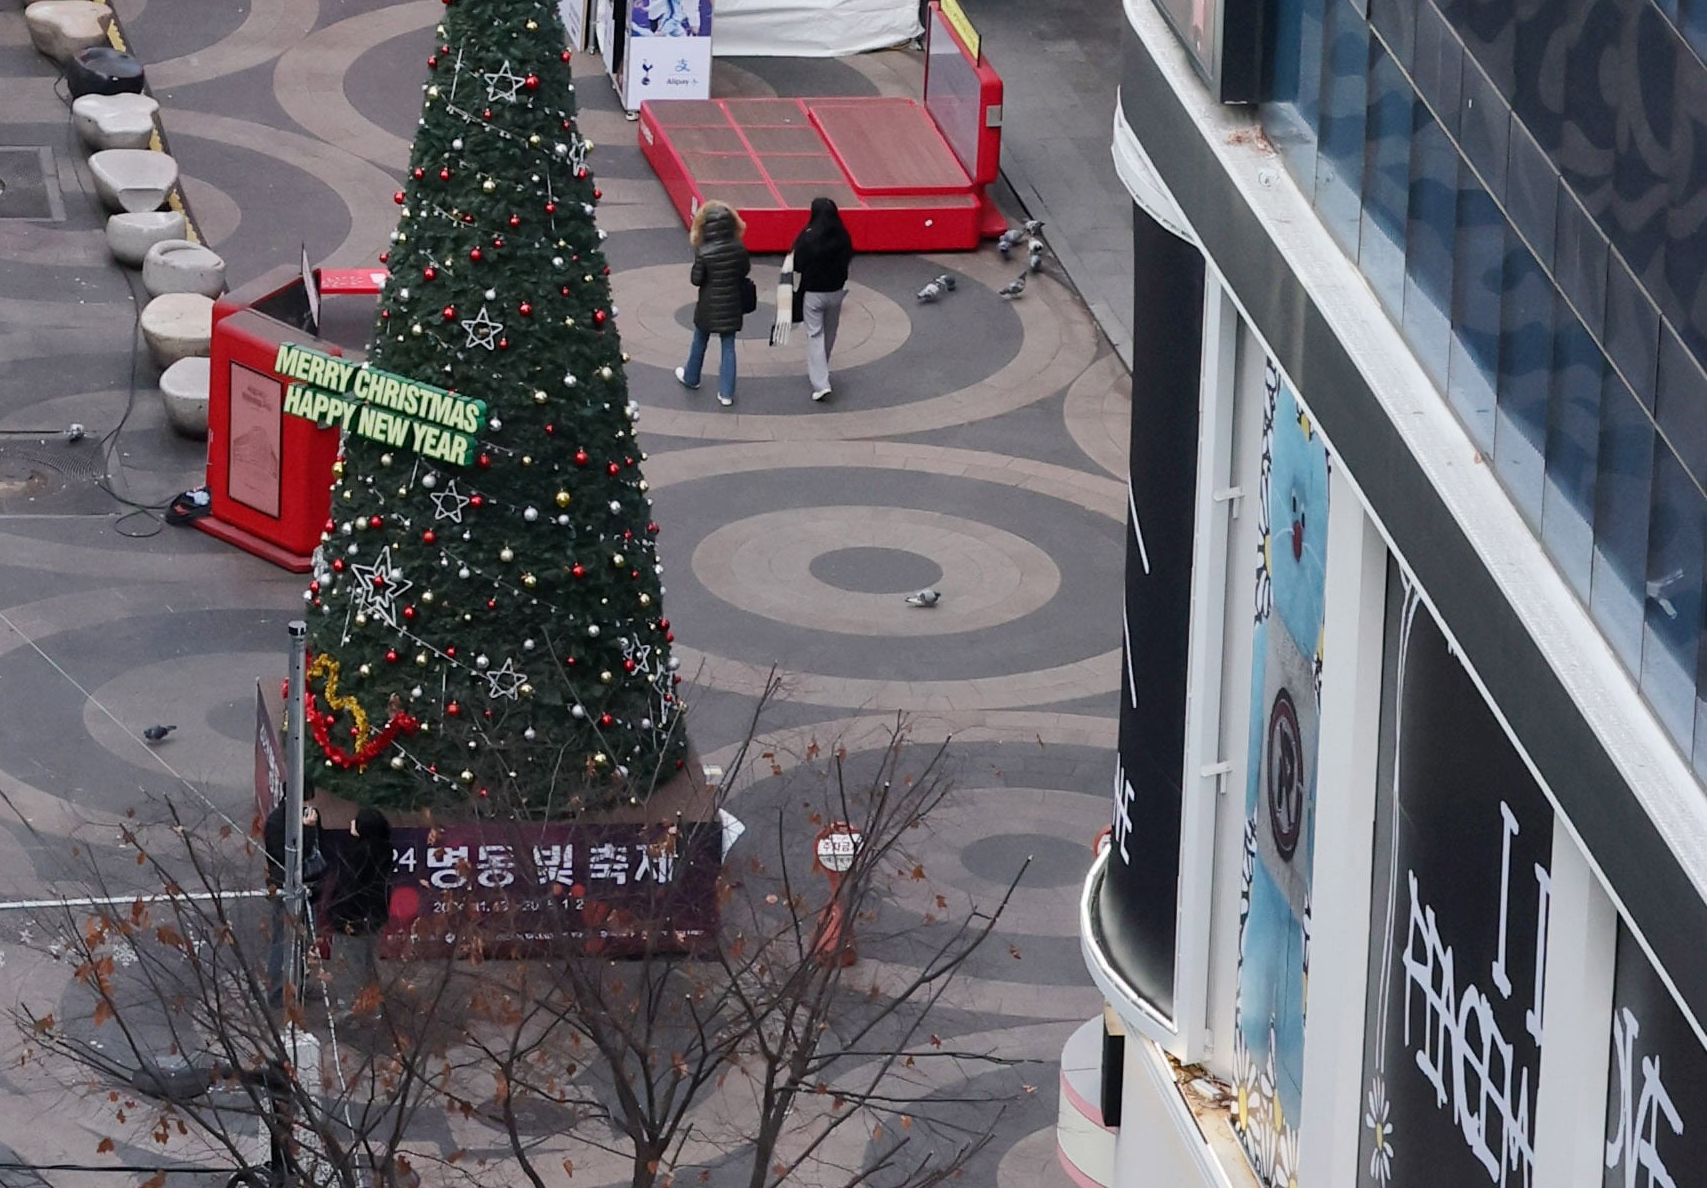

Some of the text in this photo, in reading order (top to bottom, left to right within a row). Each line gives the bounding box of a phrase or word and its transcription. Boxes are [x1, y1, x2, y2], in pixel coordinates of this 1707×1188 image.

[274, 345, 480, 434] MERRY CHRISTMAS
[284, 385, 468, 466] HAPPY NEW YEAR
[427, 846, 516, 888] 명동
